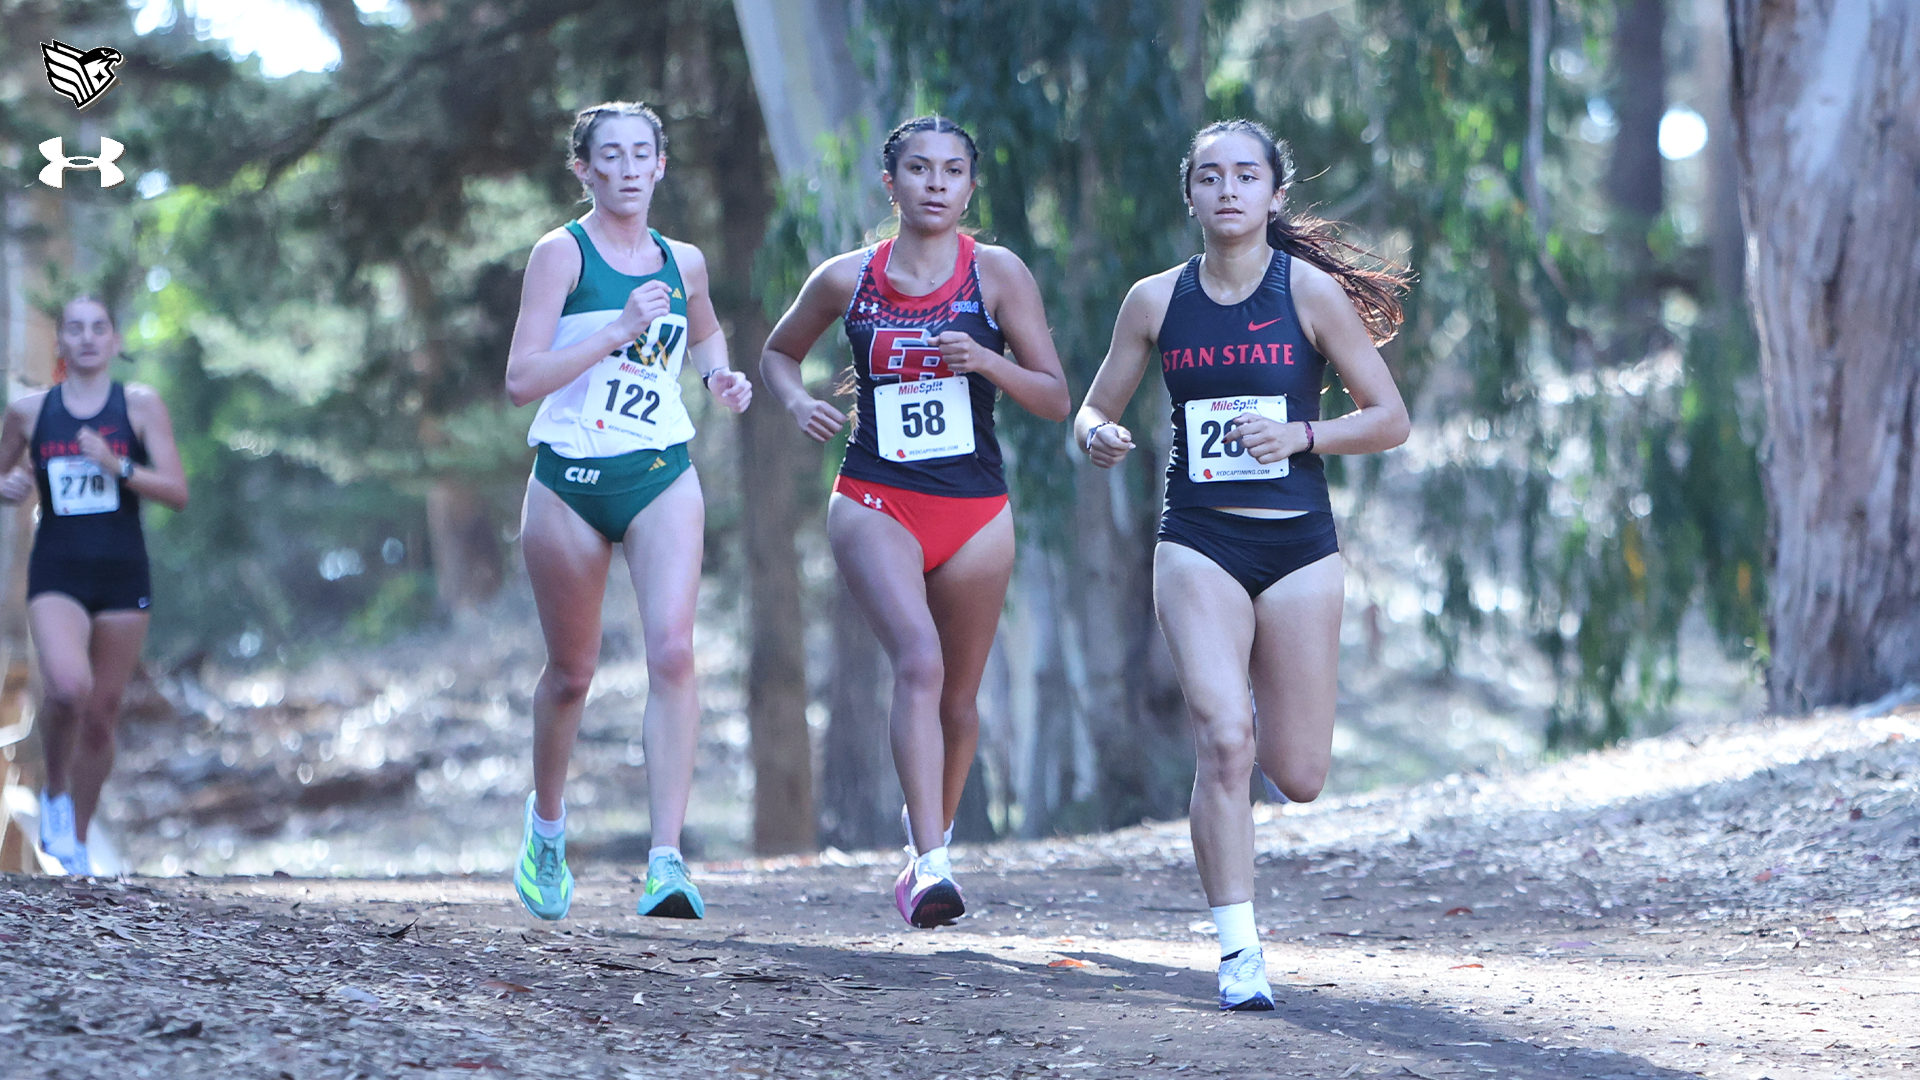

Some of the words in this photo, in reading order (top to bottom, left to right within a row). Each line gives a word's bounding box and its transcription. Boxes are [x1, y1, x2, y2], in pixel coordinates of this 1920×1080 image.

[1162, 346, 1215, 372] STAN
[1222, 343, 1295, 366] STATE
[619, 362, 658, 383] MileSplit
[899, 381, 944, 395] MileSplit
[604, 378, 660, 426] 122
[1210, 399, 1259, 412] MileSplit
[901, 400, 946, 438] 58
[60, 473, 105, 499] 270
